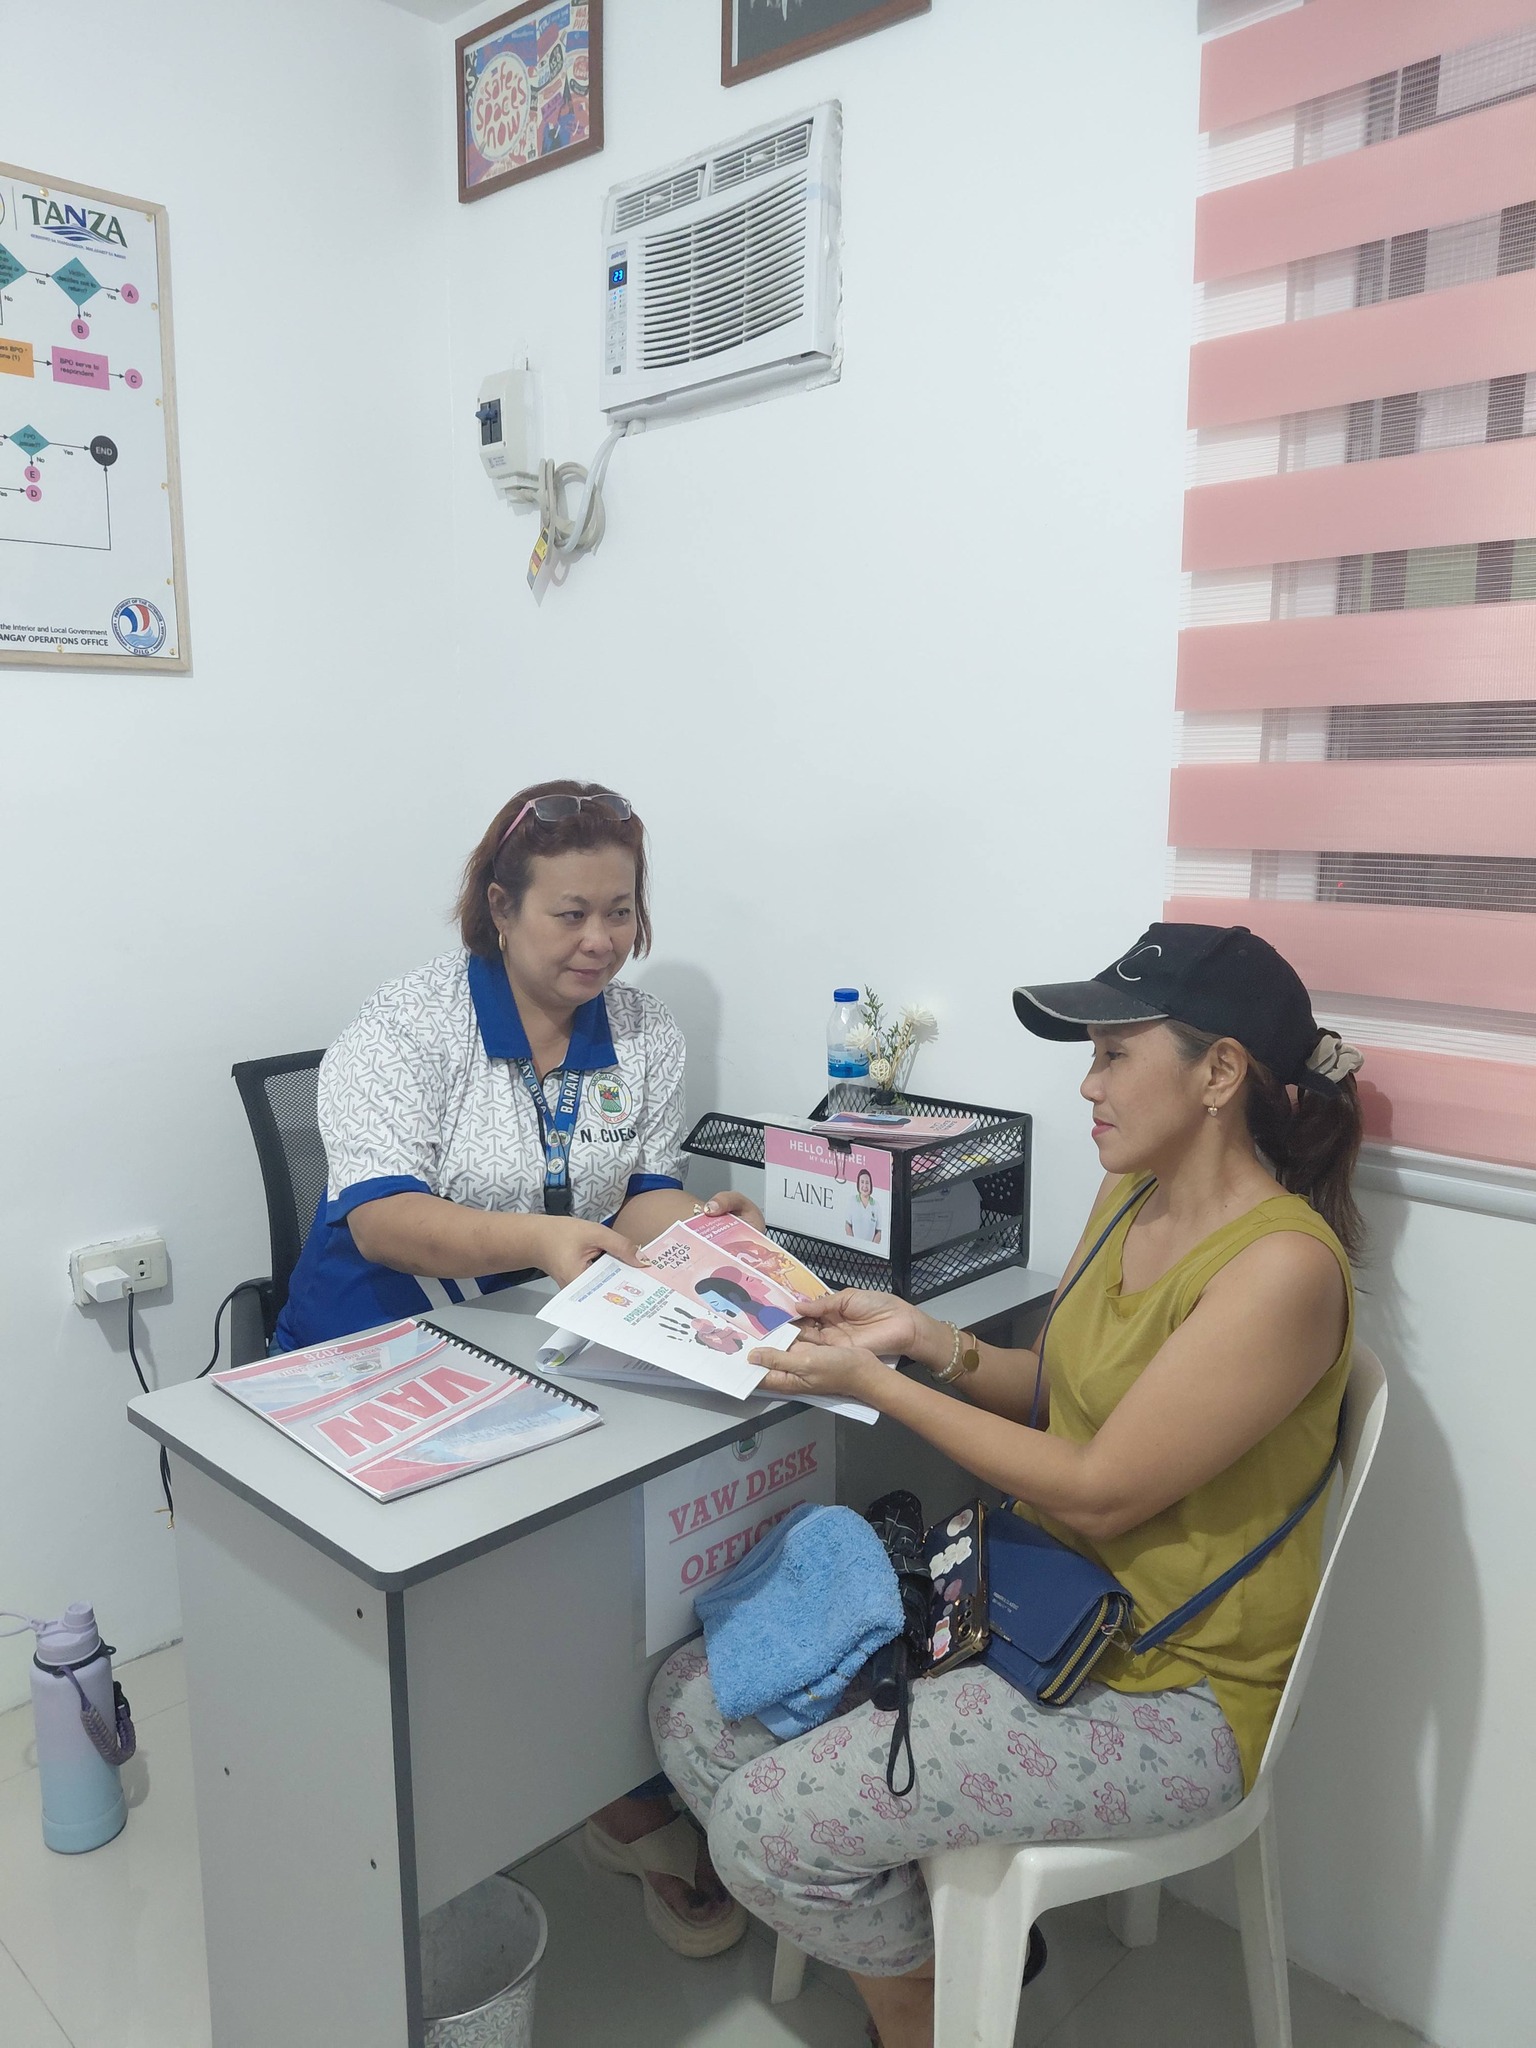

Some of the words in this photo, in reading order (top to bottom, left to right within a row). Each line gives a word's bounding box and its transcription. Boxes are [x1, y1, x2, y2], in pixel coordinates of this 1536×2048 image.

[485, 61, 513, 101] safe
[487, 111, 520, 149] now
[22, 194, 128, 248] TANZA
[613, 270, 624, 282] 23
[107, 293, 117, 301] Yes
[126, 290, 134, 299] A
[77, 325, 84, 334] B
[60, 358, 73, 366] BPO
[75, 361, 92, 369] serve
[61, 367, 94, 377] respondent
[130, 375, 137, 384] C
[95, 446, 113, 456] END
[31, 490, 37, 498] D
[51, 626, 67, 634] Local
[68, 628, 107, 636] Government
[29, 636, 79, 645] OPERATIONS
[82, 639, 109, 647] OFFICE
[530, 1084, 546, 1114] BIGA
[580, 1128, 597, 1143] N.
[789, 1139, 824, 1156] HELLO
[783, 1177, 834, 1210] LAINE
[651, 1242, 683, 1266] BAWAL
[657, 1245, 691, 1270] BASTOS
[670, 1254, 690, 1270] LAW
[303, 1347, 343, 1361] 2026
[316, 1365, 494, 1458] VAW
[668, 1480, 739, 1535] VAW
[746, 1441, 817, 1501] DESK
[680, 1499, 806, 1586] OFFIC
